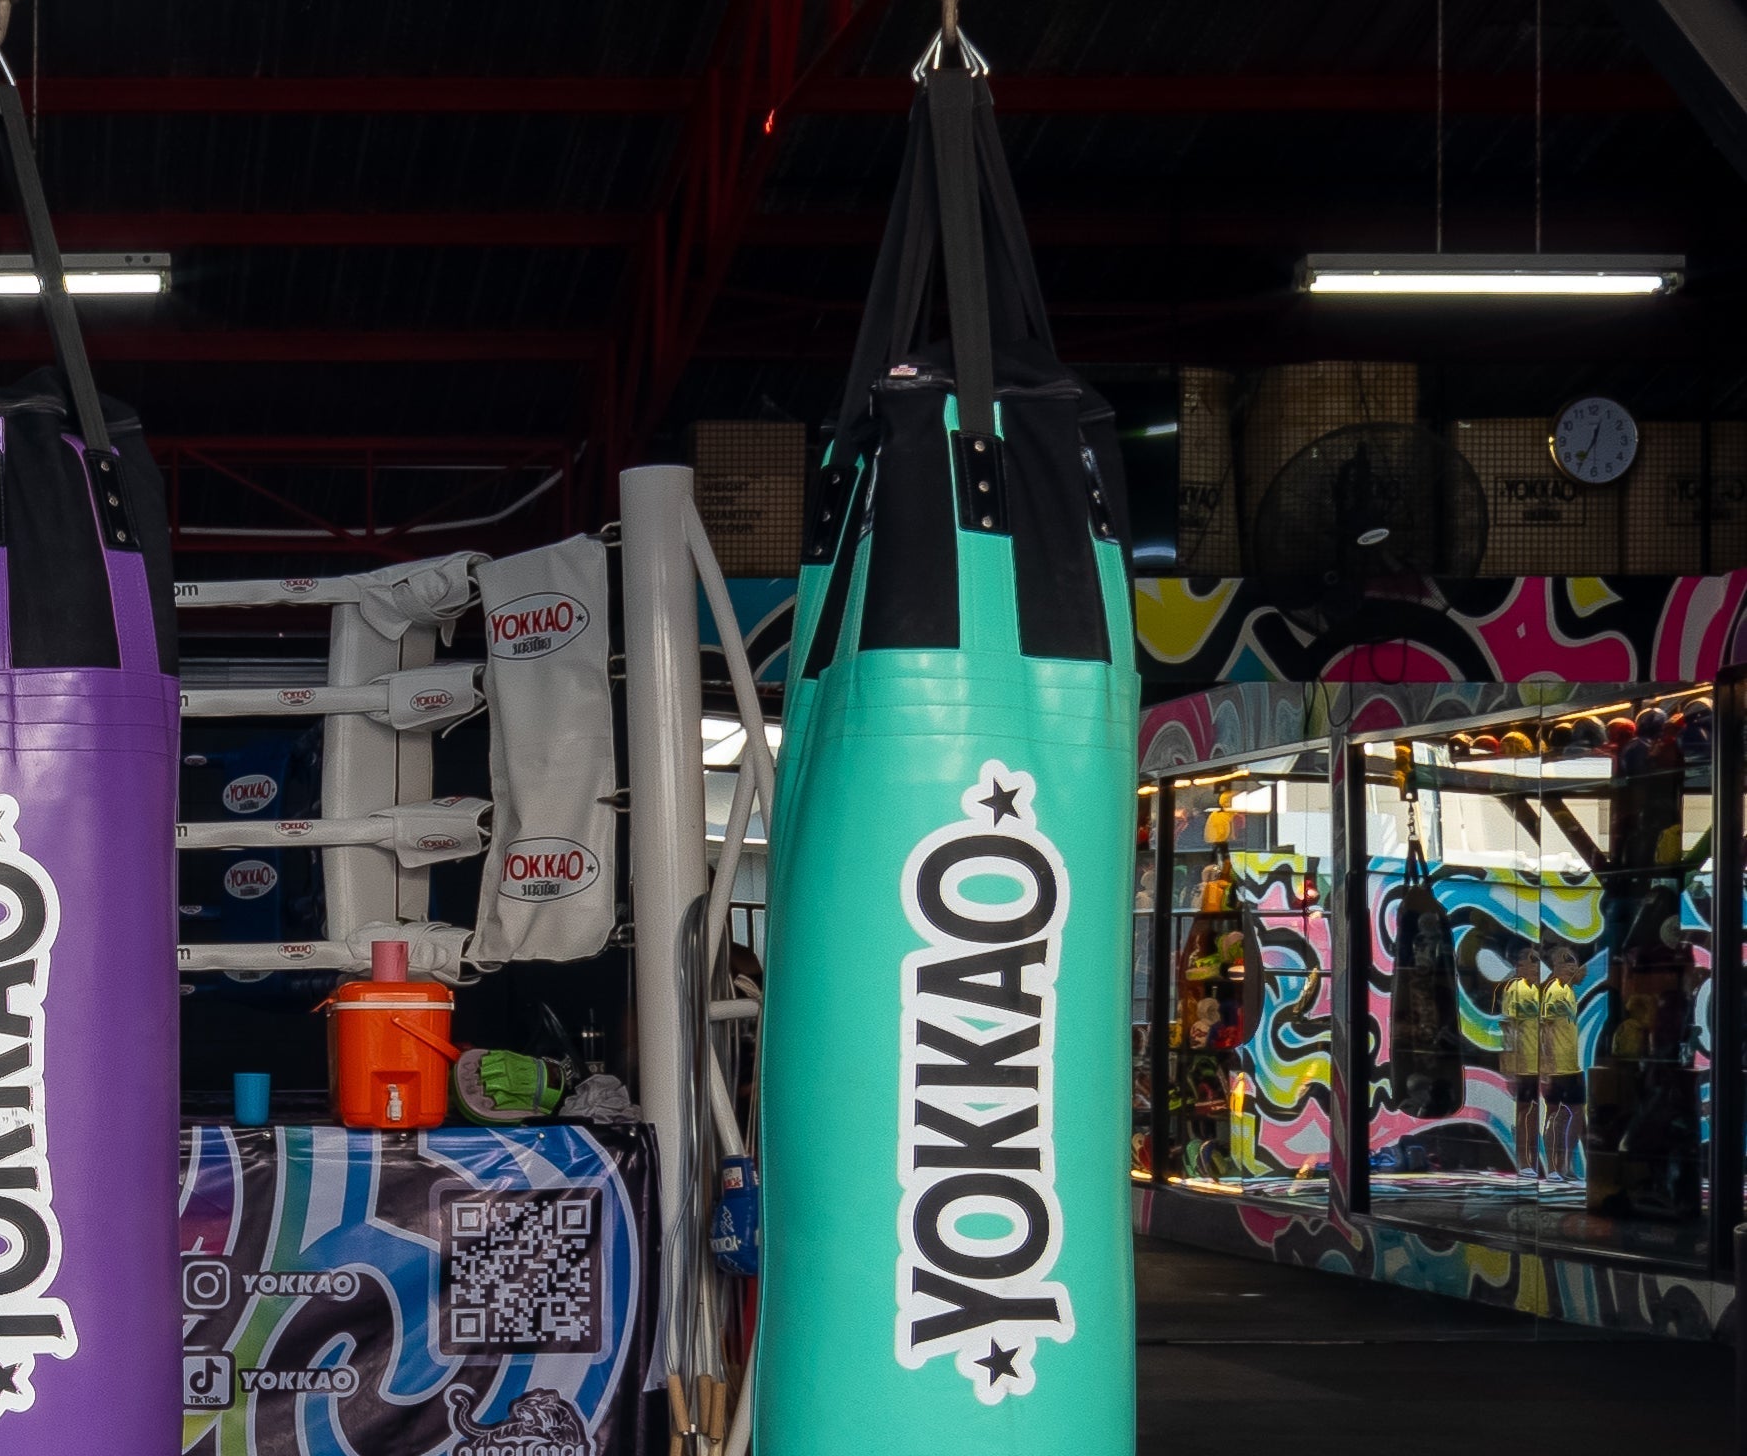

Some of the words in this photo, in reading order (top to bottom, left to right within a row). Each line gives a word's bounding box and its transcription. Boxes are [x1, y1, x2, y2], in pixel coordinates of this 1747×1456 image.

[1573, 409, 1584, 419] 11
[1588, 405, 1599, 416] 12
[1606, 410, 1611, 419] 1
[1563, 421, 1573, 431] 10
[1615, 420, 1623, 431] 2
[1558, 436, 1566, 447] 9
[1620, 435, 1628, 446] 3
[1564, 452, 1572, 463] 8
[1616, 451, 1623, 461] 4
[1576, 462, 1583, 473] 7
[1590, 466, 1598, 477] 6
[1605, 463, 1613, 473] 5
[491, 601, 574, 644] YOKKAO
[229, 779, 271, 802] YOKKAO
[502, 850, 584, 882] YOKKAO
[230, 867, 271, 888] YOKKAO
[910, 833, 1062, 1350] YOKKAO
[241, 1274, 353, 1294] YOKKAO
[241, 1371, 352, 1390] YOKKAO
[189, 1395, 222, 1404] TikTok
